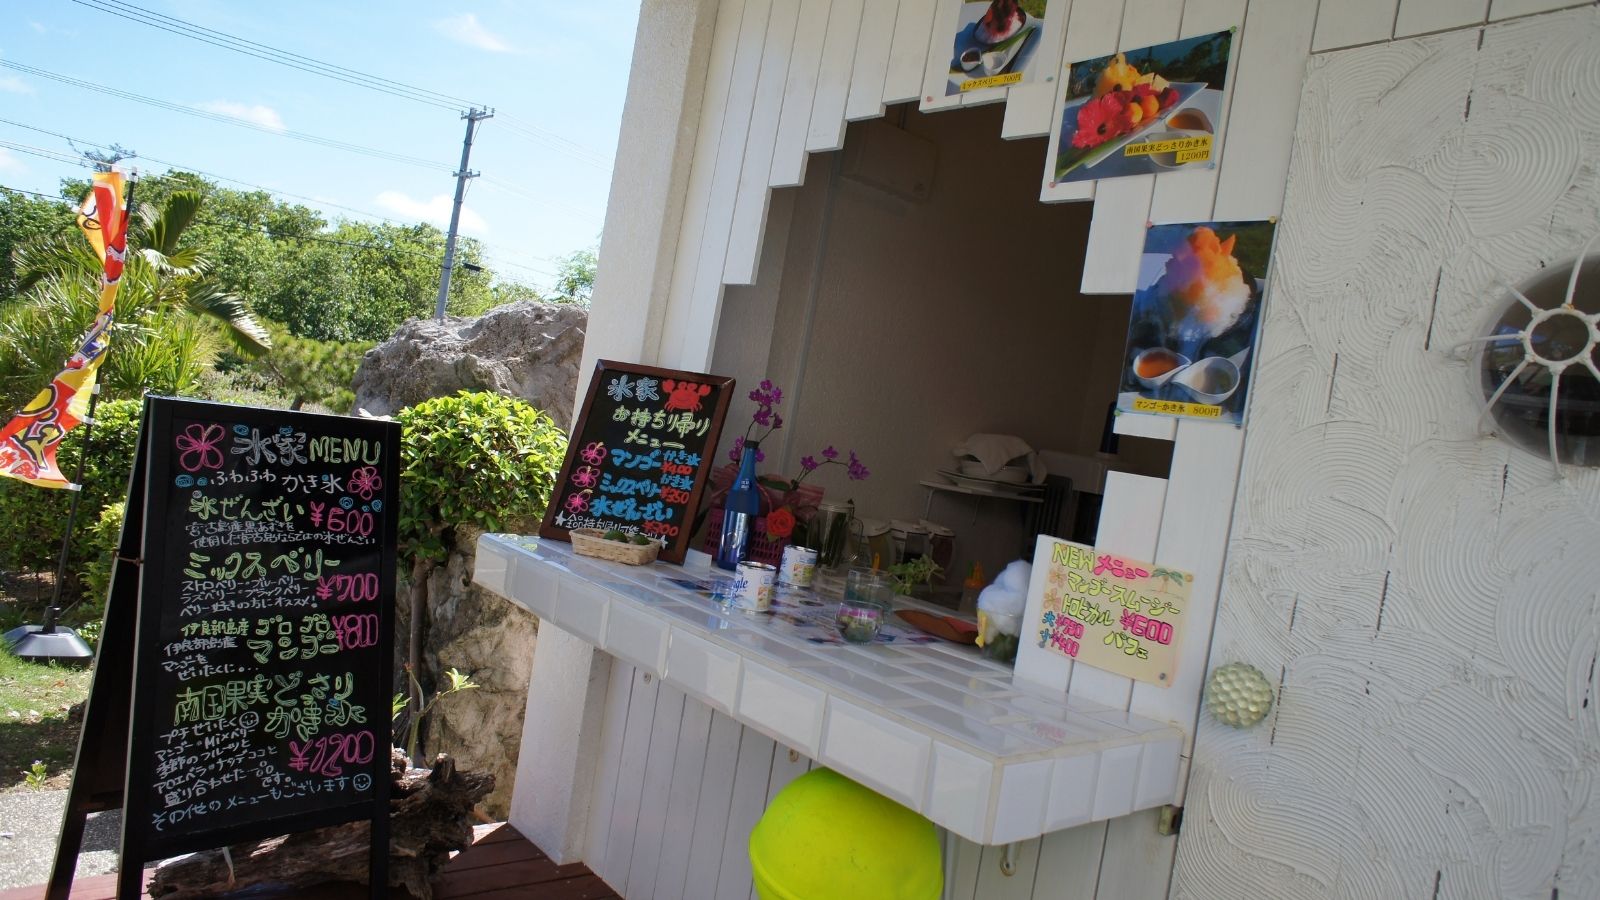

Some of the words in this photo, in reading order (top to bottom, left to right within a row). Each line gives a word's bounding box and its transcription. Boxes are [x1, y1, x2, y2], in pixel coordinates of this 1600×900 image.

[1126, 137, 1208, 155] 南国果実どっさりかき氷
[1181, 150, 1209, 161] 1200円
[1136, 400, 1185, 413] マンゴーかき氷
[1192, 406, 1219, 417] 800円
[310, 435, 381, 465] MENU
[623, 428, 685, 450] メニュー
[610, 448, 662, 470] マンゴー
[211, 470, 277, 486] ふわふわ
[310, 501, 374, 536] ¥600
[183, 547, 341, 580] ミックスベリー
[1052, 542, 1095, 573] NEW
[1093, 555, 1149, 580] メニュー
[316, 573, 379, 601] ¥700
[247, 632, 340, 664] マンゴー
[1103, 631, 1148, 660] パフェ
[287, 731, 375, 777] ¥1200
